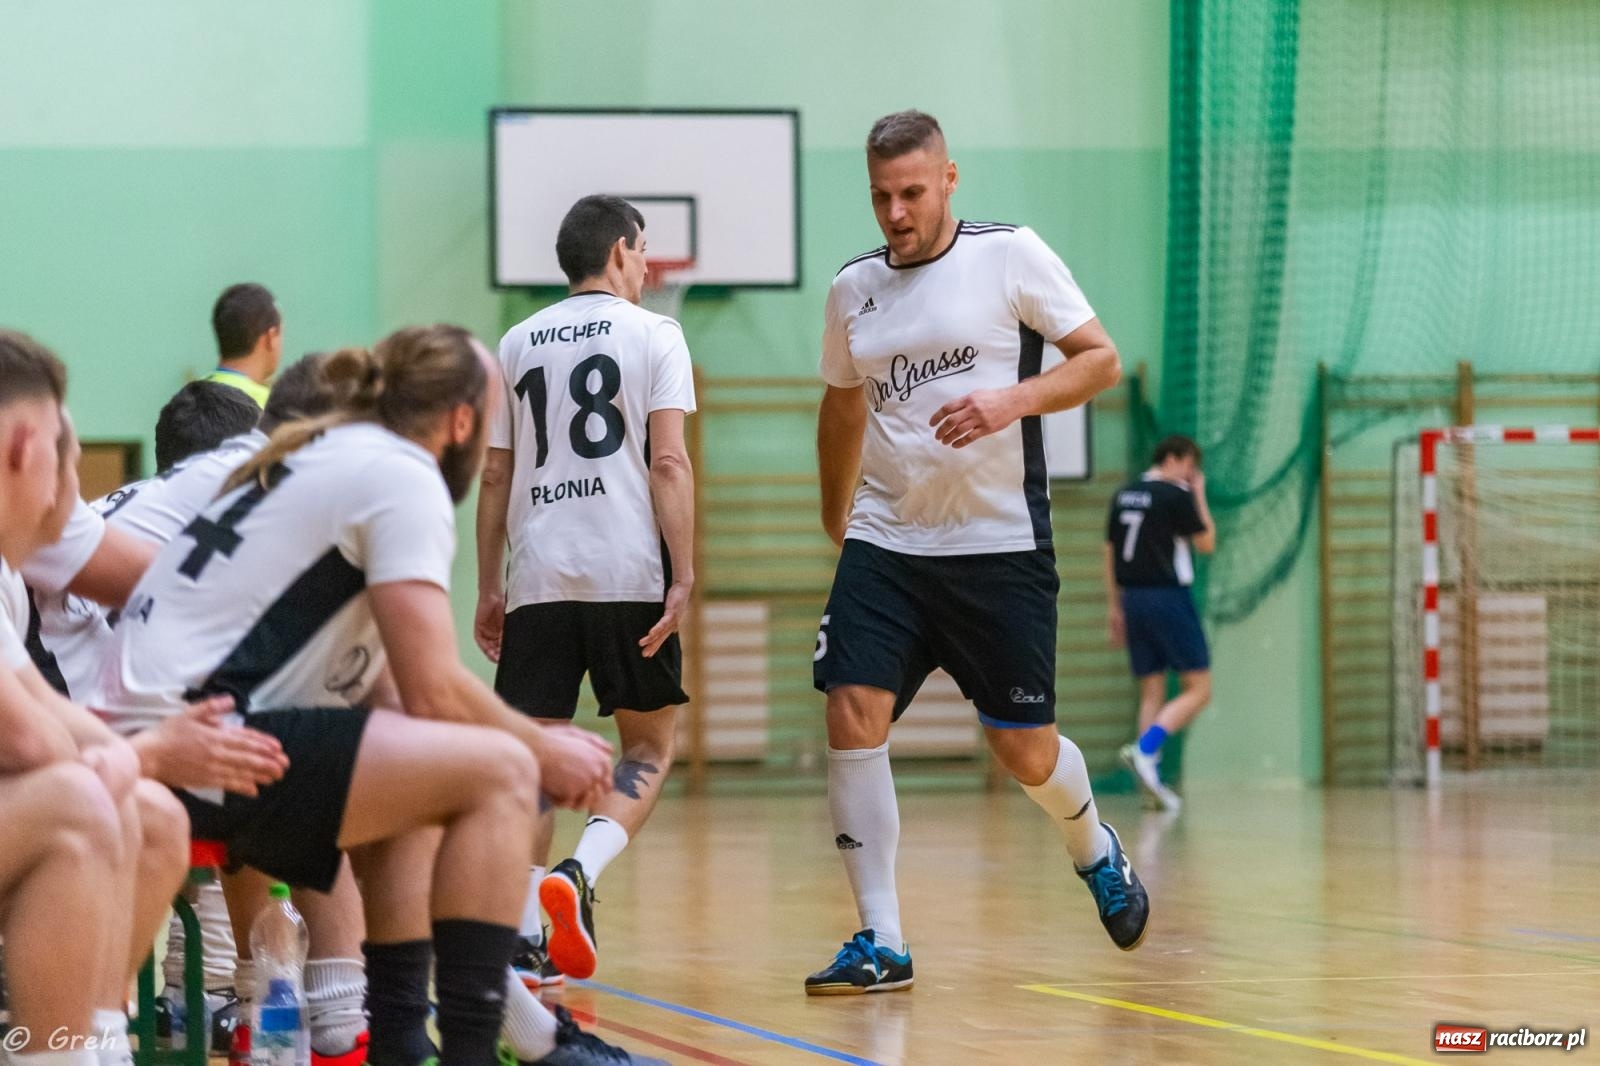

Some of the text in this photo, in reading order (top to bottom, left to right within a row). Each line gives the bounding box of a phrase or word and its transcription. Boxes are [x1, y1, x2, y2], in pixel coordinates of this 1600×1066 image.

[530, 320, 612, 347] WICHER
[514, 353, 625, 470] 18
[530, 476, 607, 506] PŁONIA
[1119, 509, 1145, 562] 7
